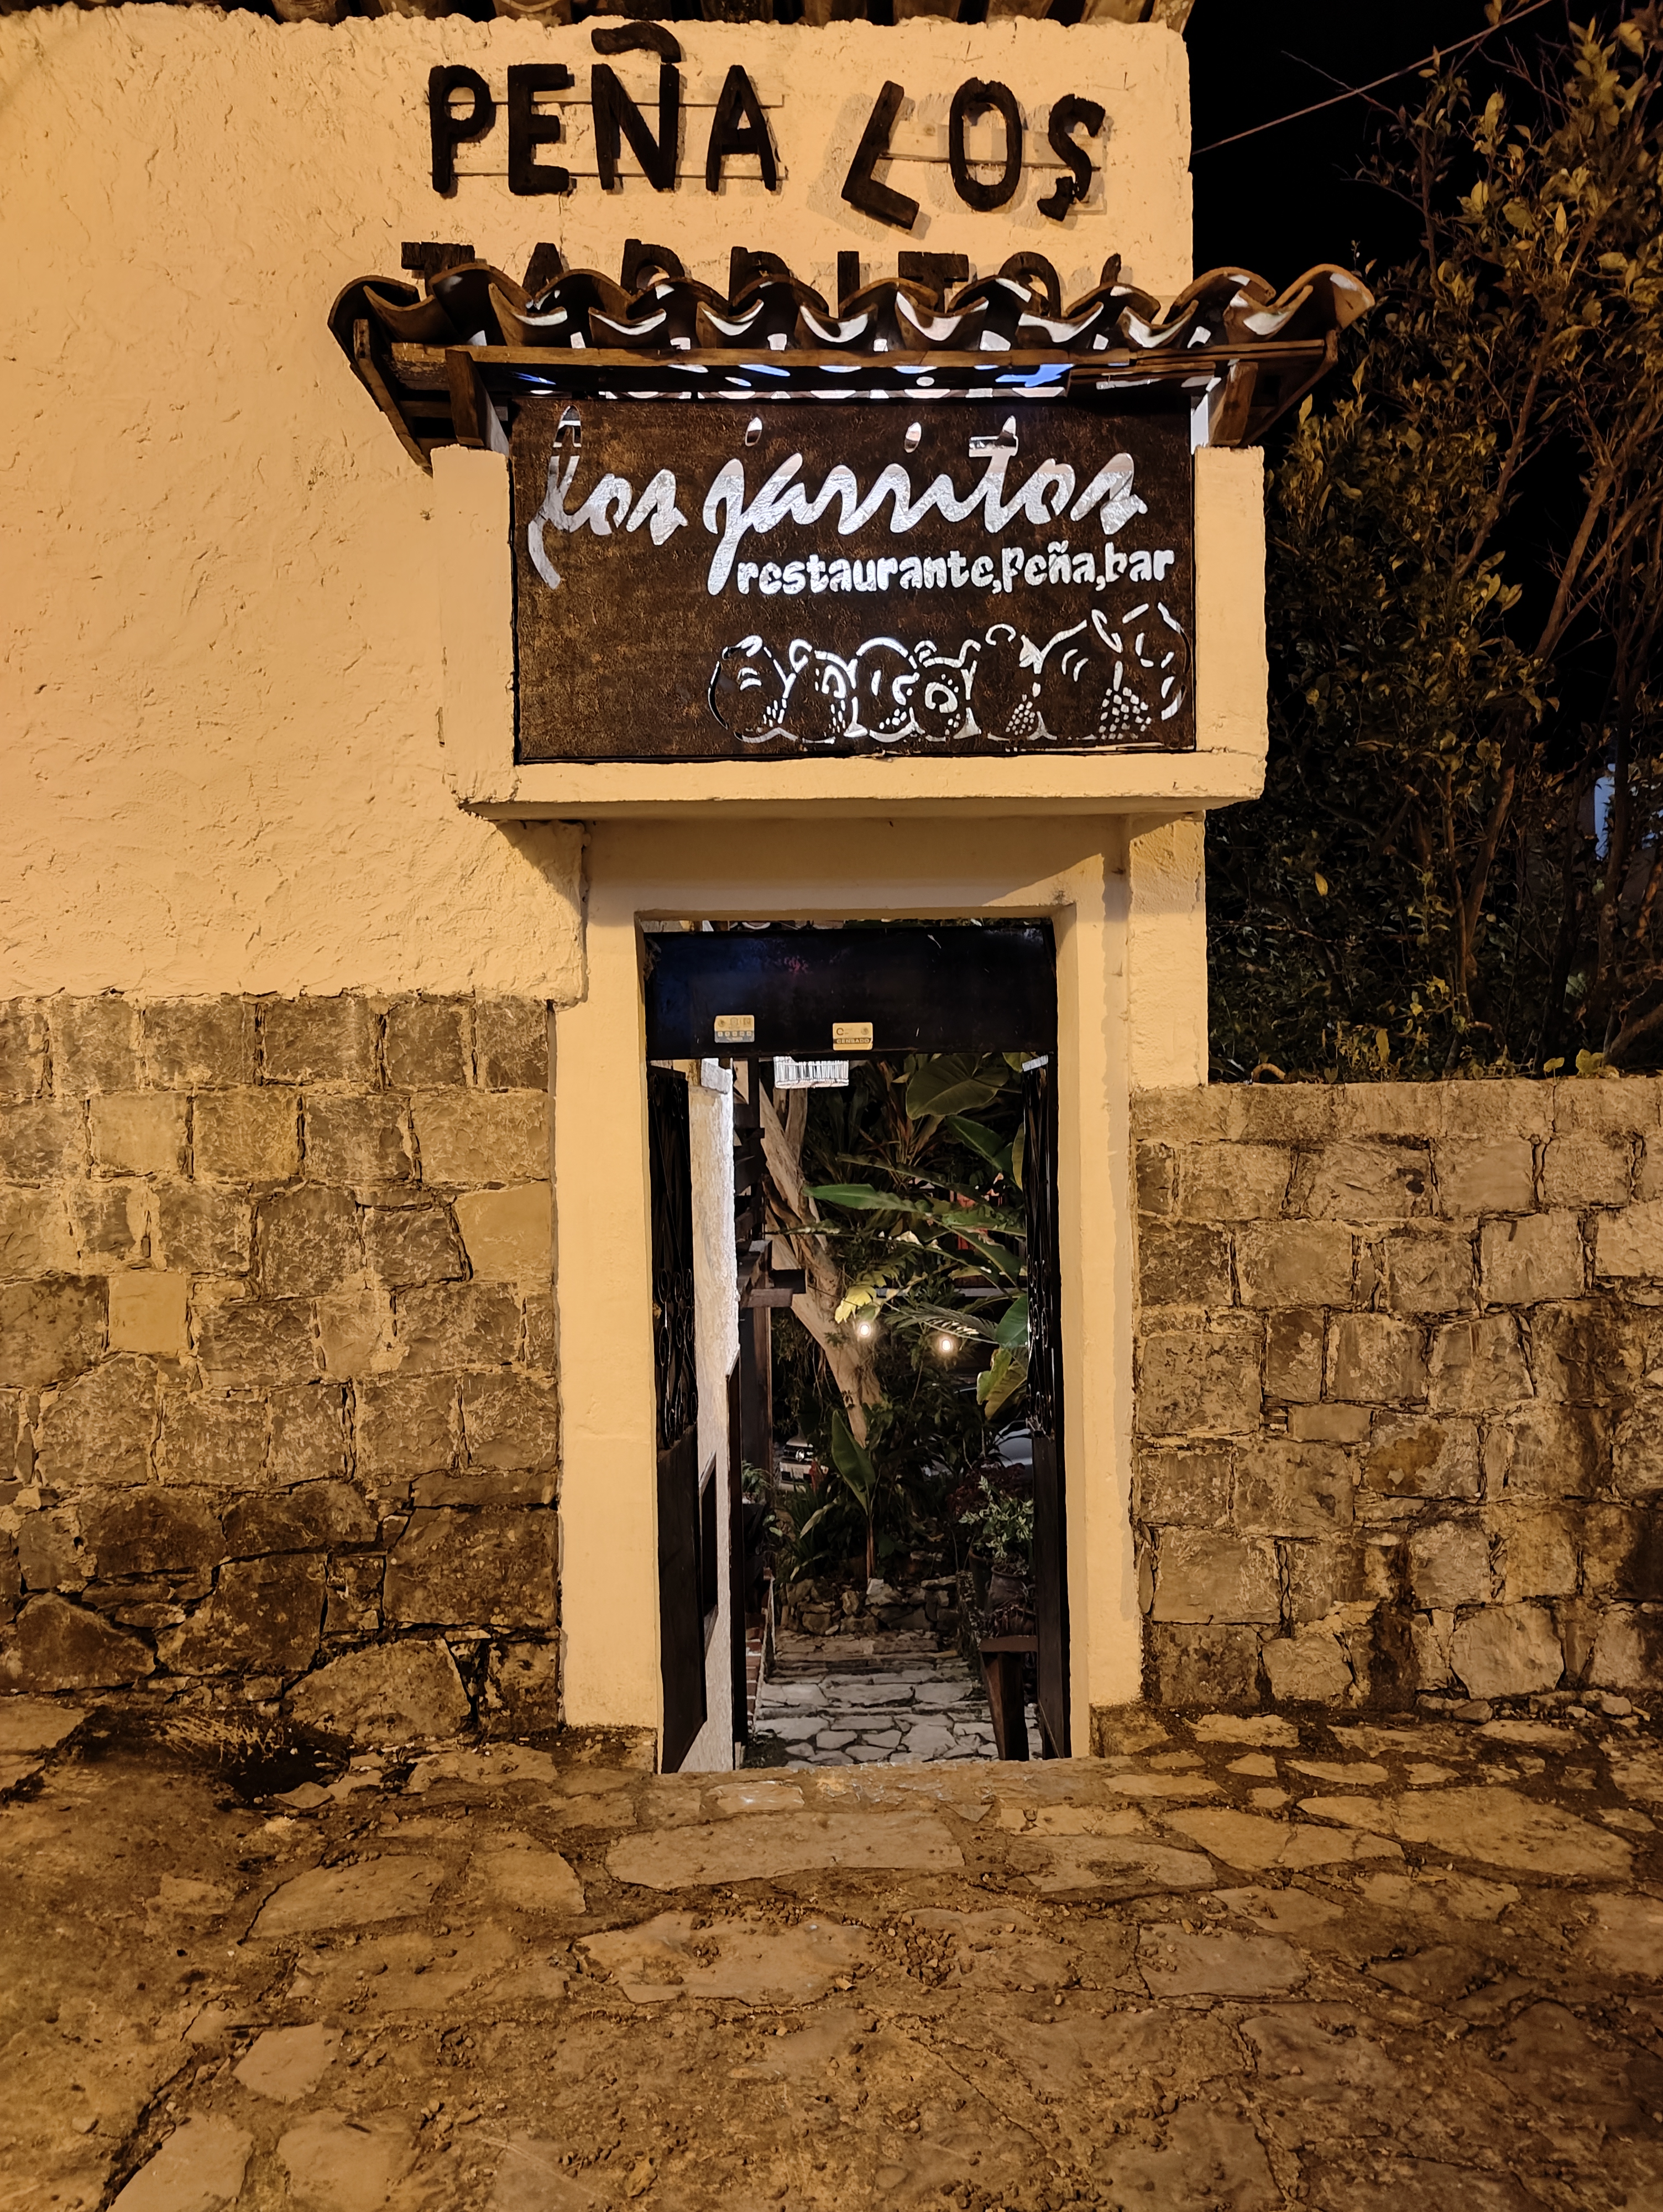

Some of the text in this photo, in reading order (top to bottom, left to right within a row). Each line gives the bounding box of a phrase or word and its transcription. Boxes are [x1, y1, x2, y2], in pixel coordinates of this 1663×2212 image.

[428, 20, 1106, 231] PEÑA LOS
[1105, 541, 1175, 583] bar
